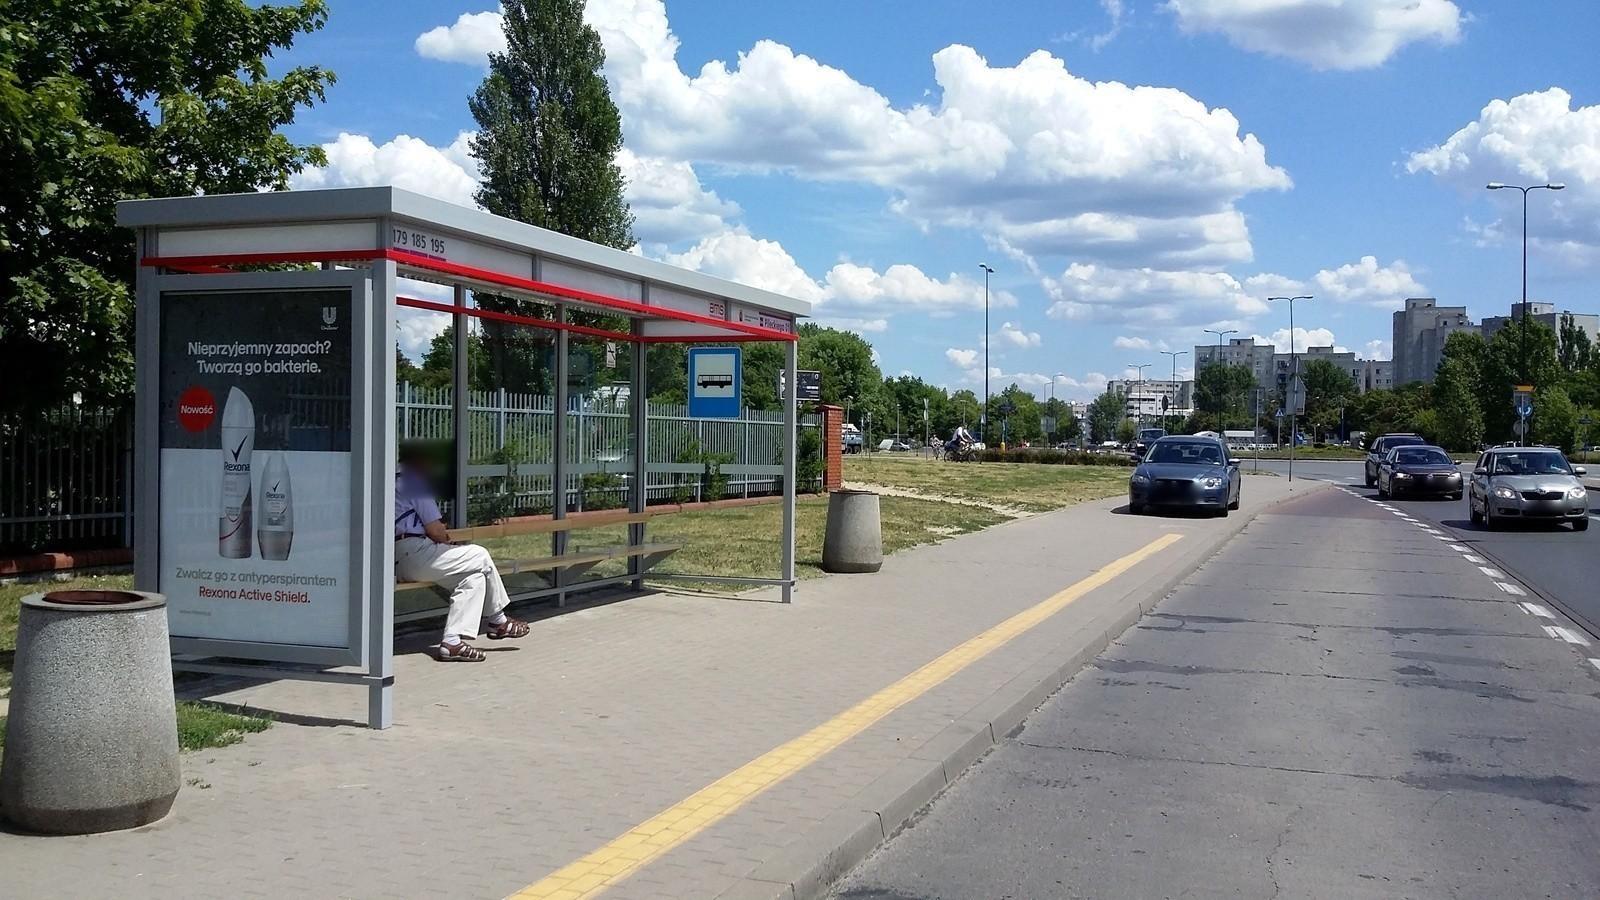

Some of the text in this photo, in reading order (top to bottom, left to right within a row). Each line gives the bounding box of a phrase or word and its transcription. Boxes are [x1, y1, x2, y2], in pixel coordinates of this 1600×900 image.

[393, 229, 445, 254] 179 185 195
[187, 340, 332, 357] Nieprzyjemny zapach?
[197, 359, 322, 376] Tworzą go bakterie.
[180, 404, 214, 415] Nowość
[224, 461, 251, 472] Rexona
[175, 567, 337, 587] Zwalcz go z antyperspirantem
[199, 586, 311, 604] Rexona Active Shield.
